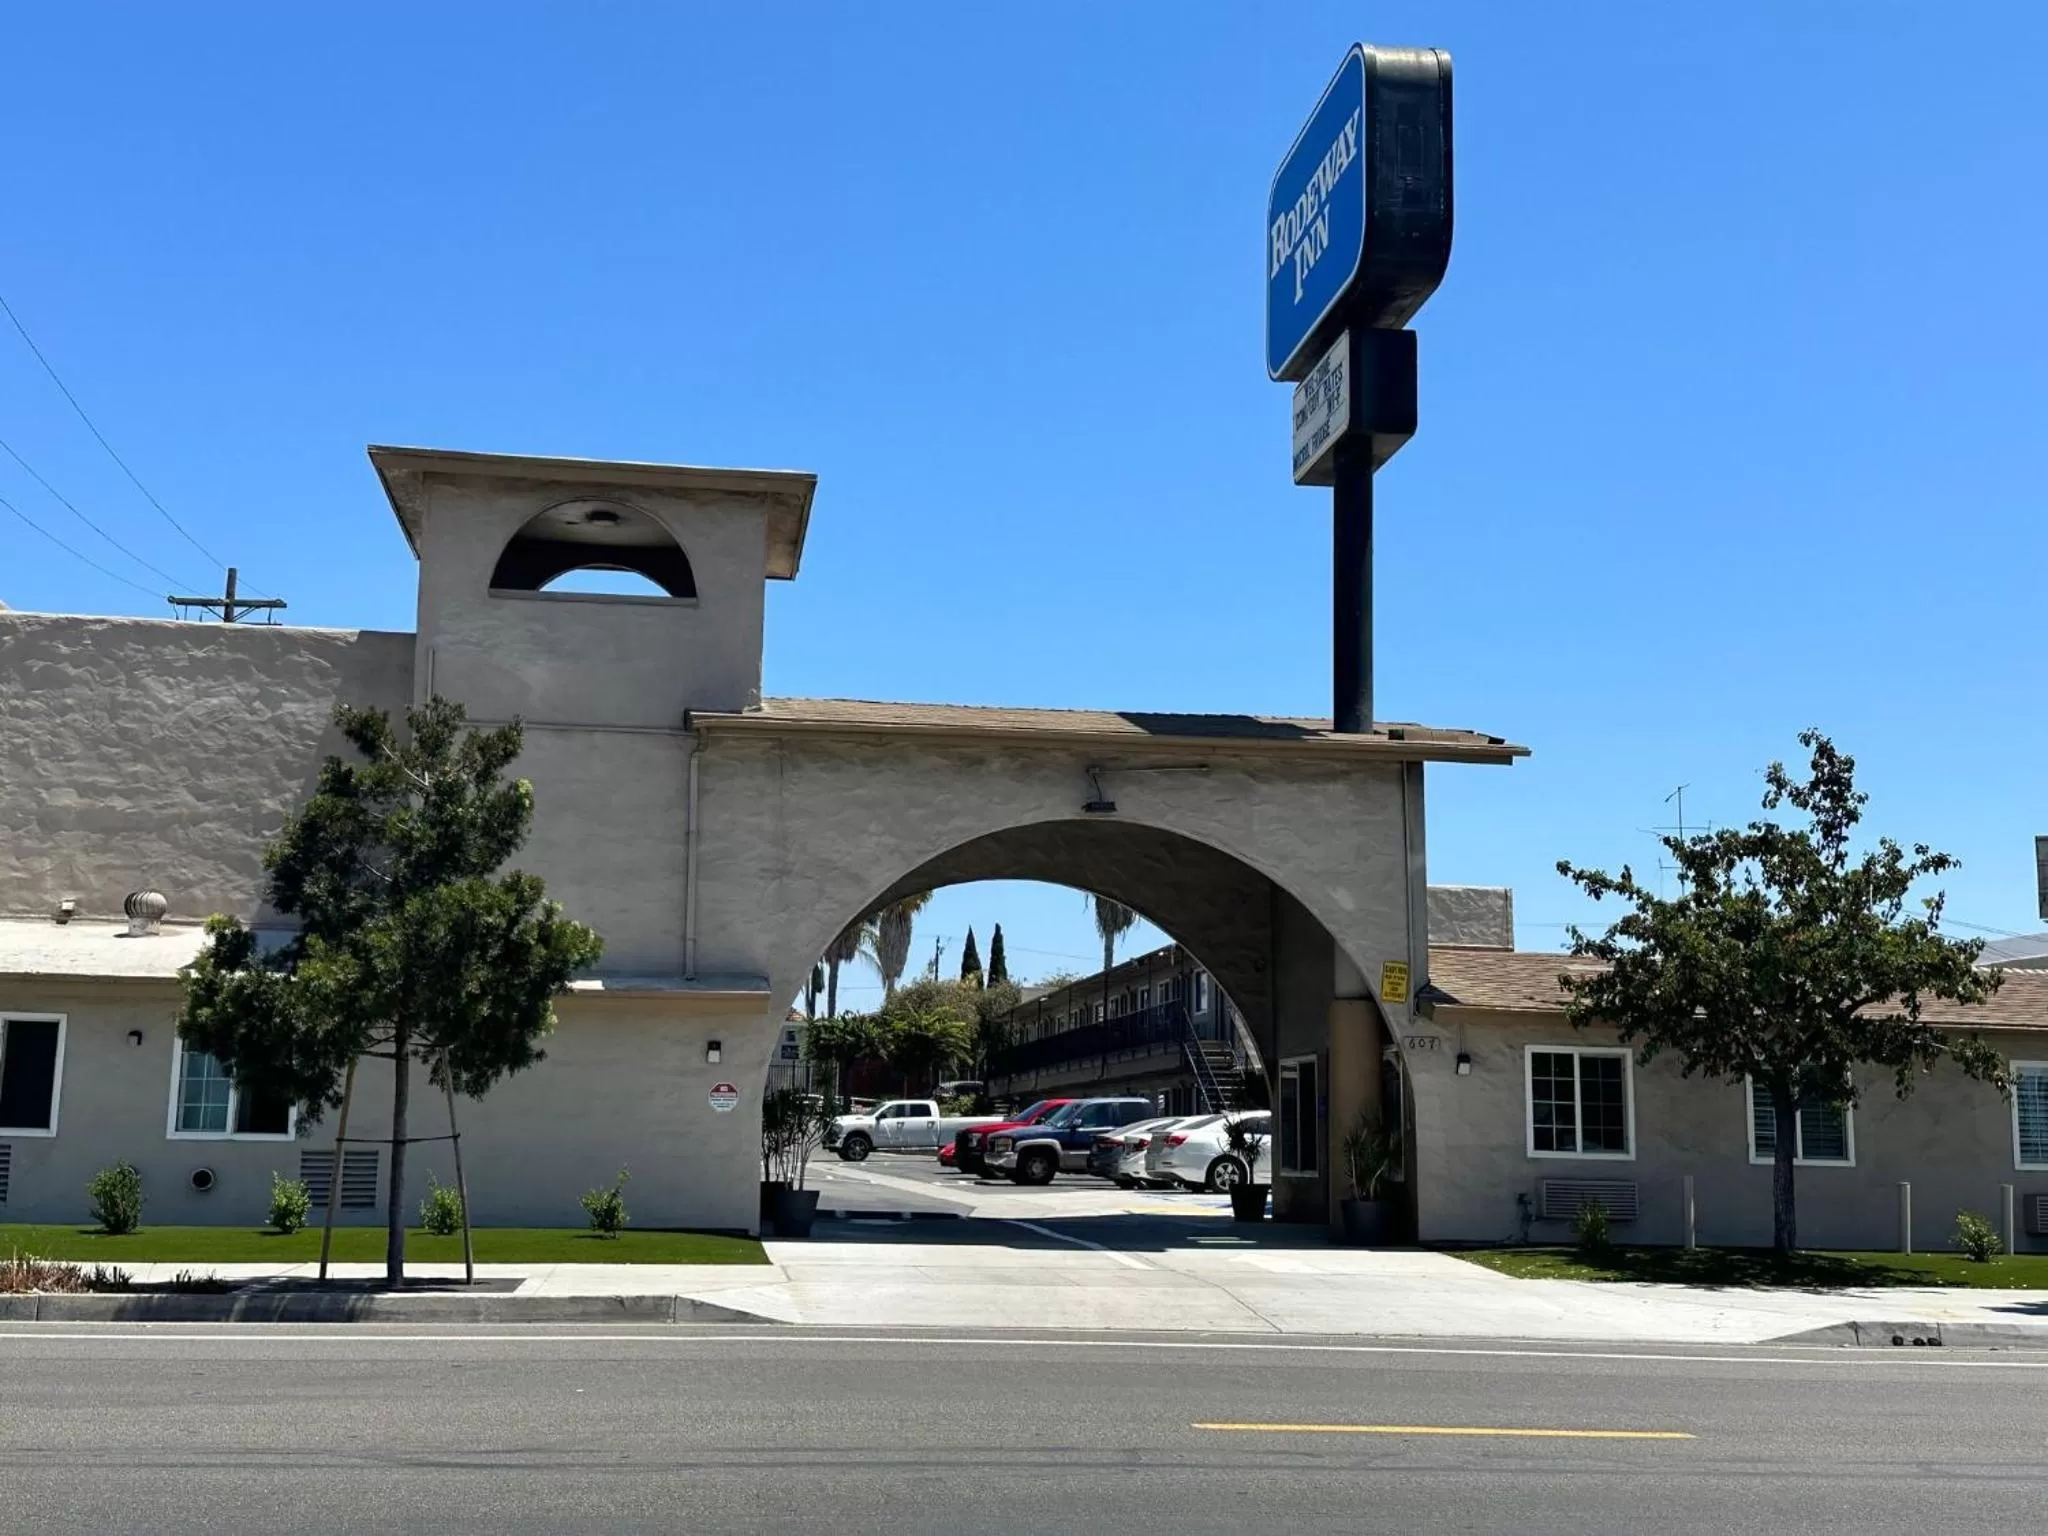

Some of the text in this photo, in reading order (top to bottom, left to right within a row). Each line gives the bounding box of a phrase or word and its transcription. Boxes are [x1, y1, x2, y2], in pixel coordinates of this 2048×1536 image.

[1271, 105, 1361, 281] RODEWAY
[1294, 203, 1330, 305] INN
[1408, 1038, 1435, 1049] 607
